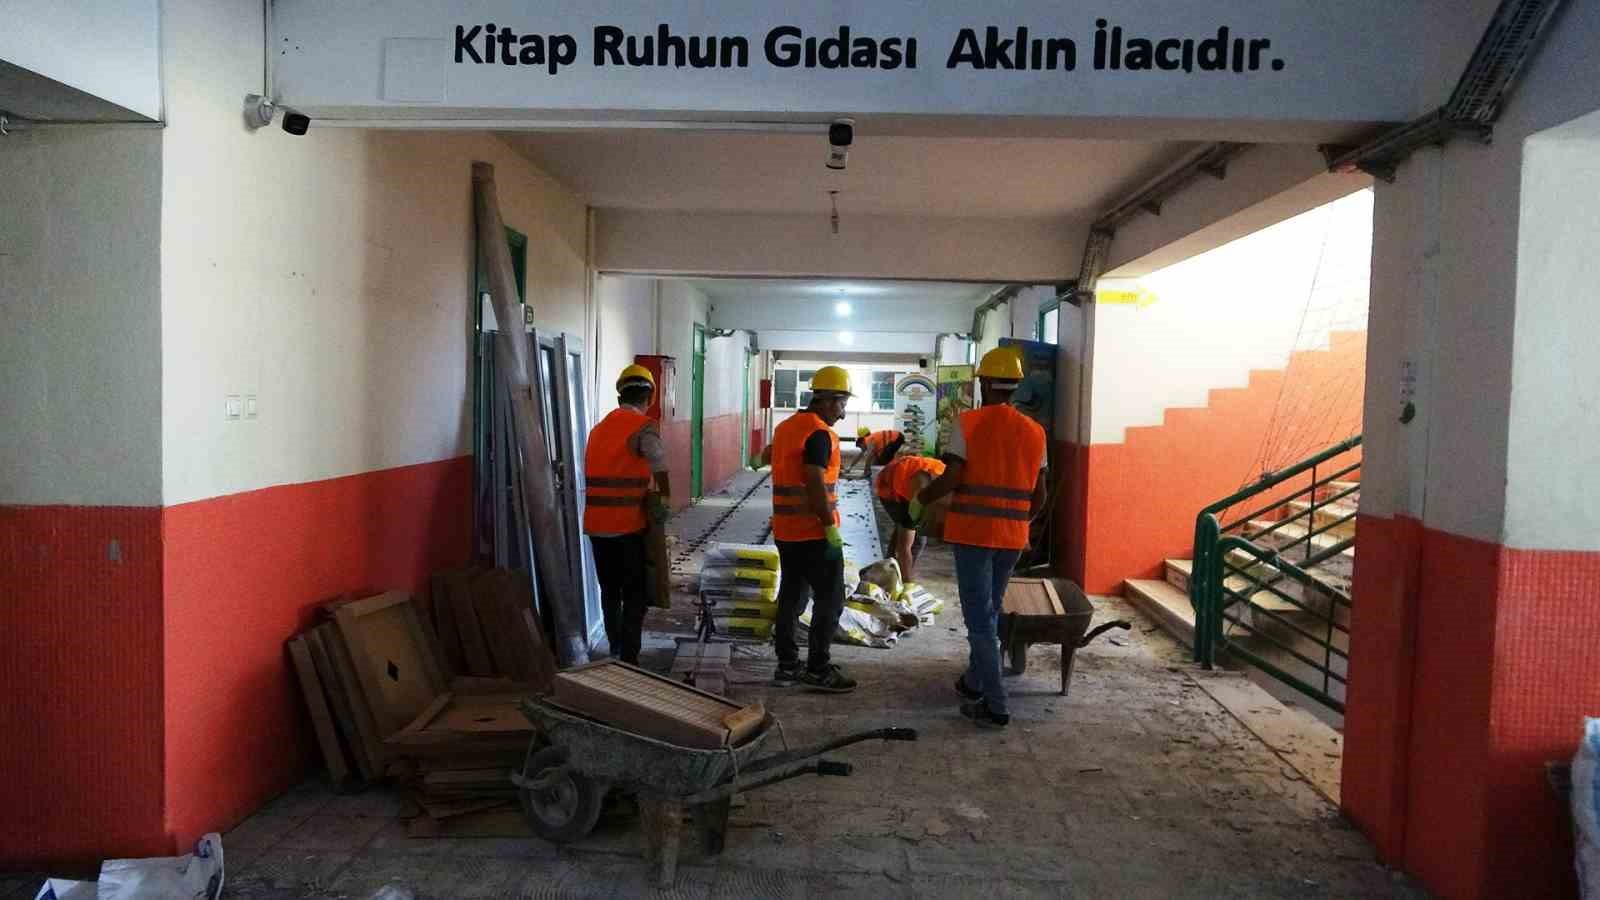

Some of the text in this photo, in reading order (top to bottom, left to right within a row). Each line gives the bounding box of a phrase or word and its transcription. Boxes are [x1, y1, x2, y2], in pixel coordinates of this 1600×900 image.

[454, 17, 1287, 75] Kitap Ruhun Gıdası Aklın İlacıdır.
